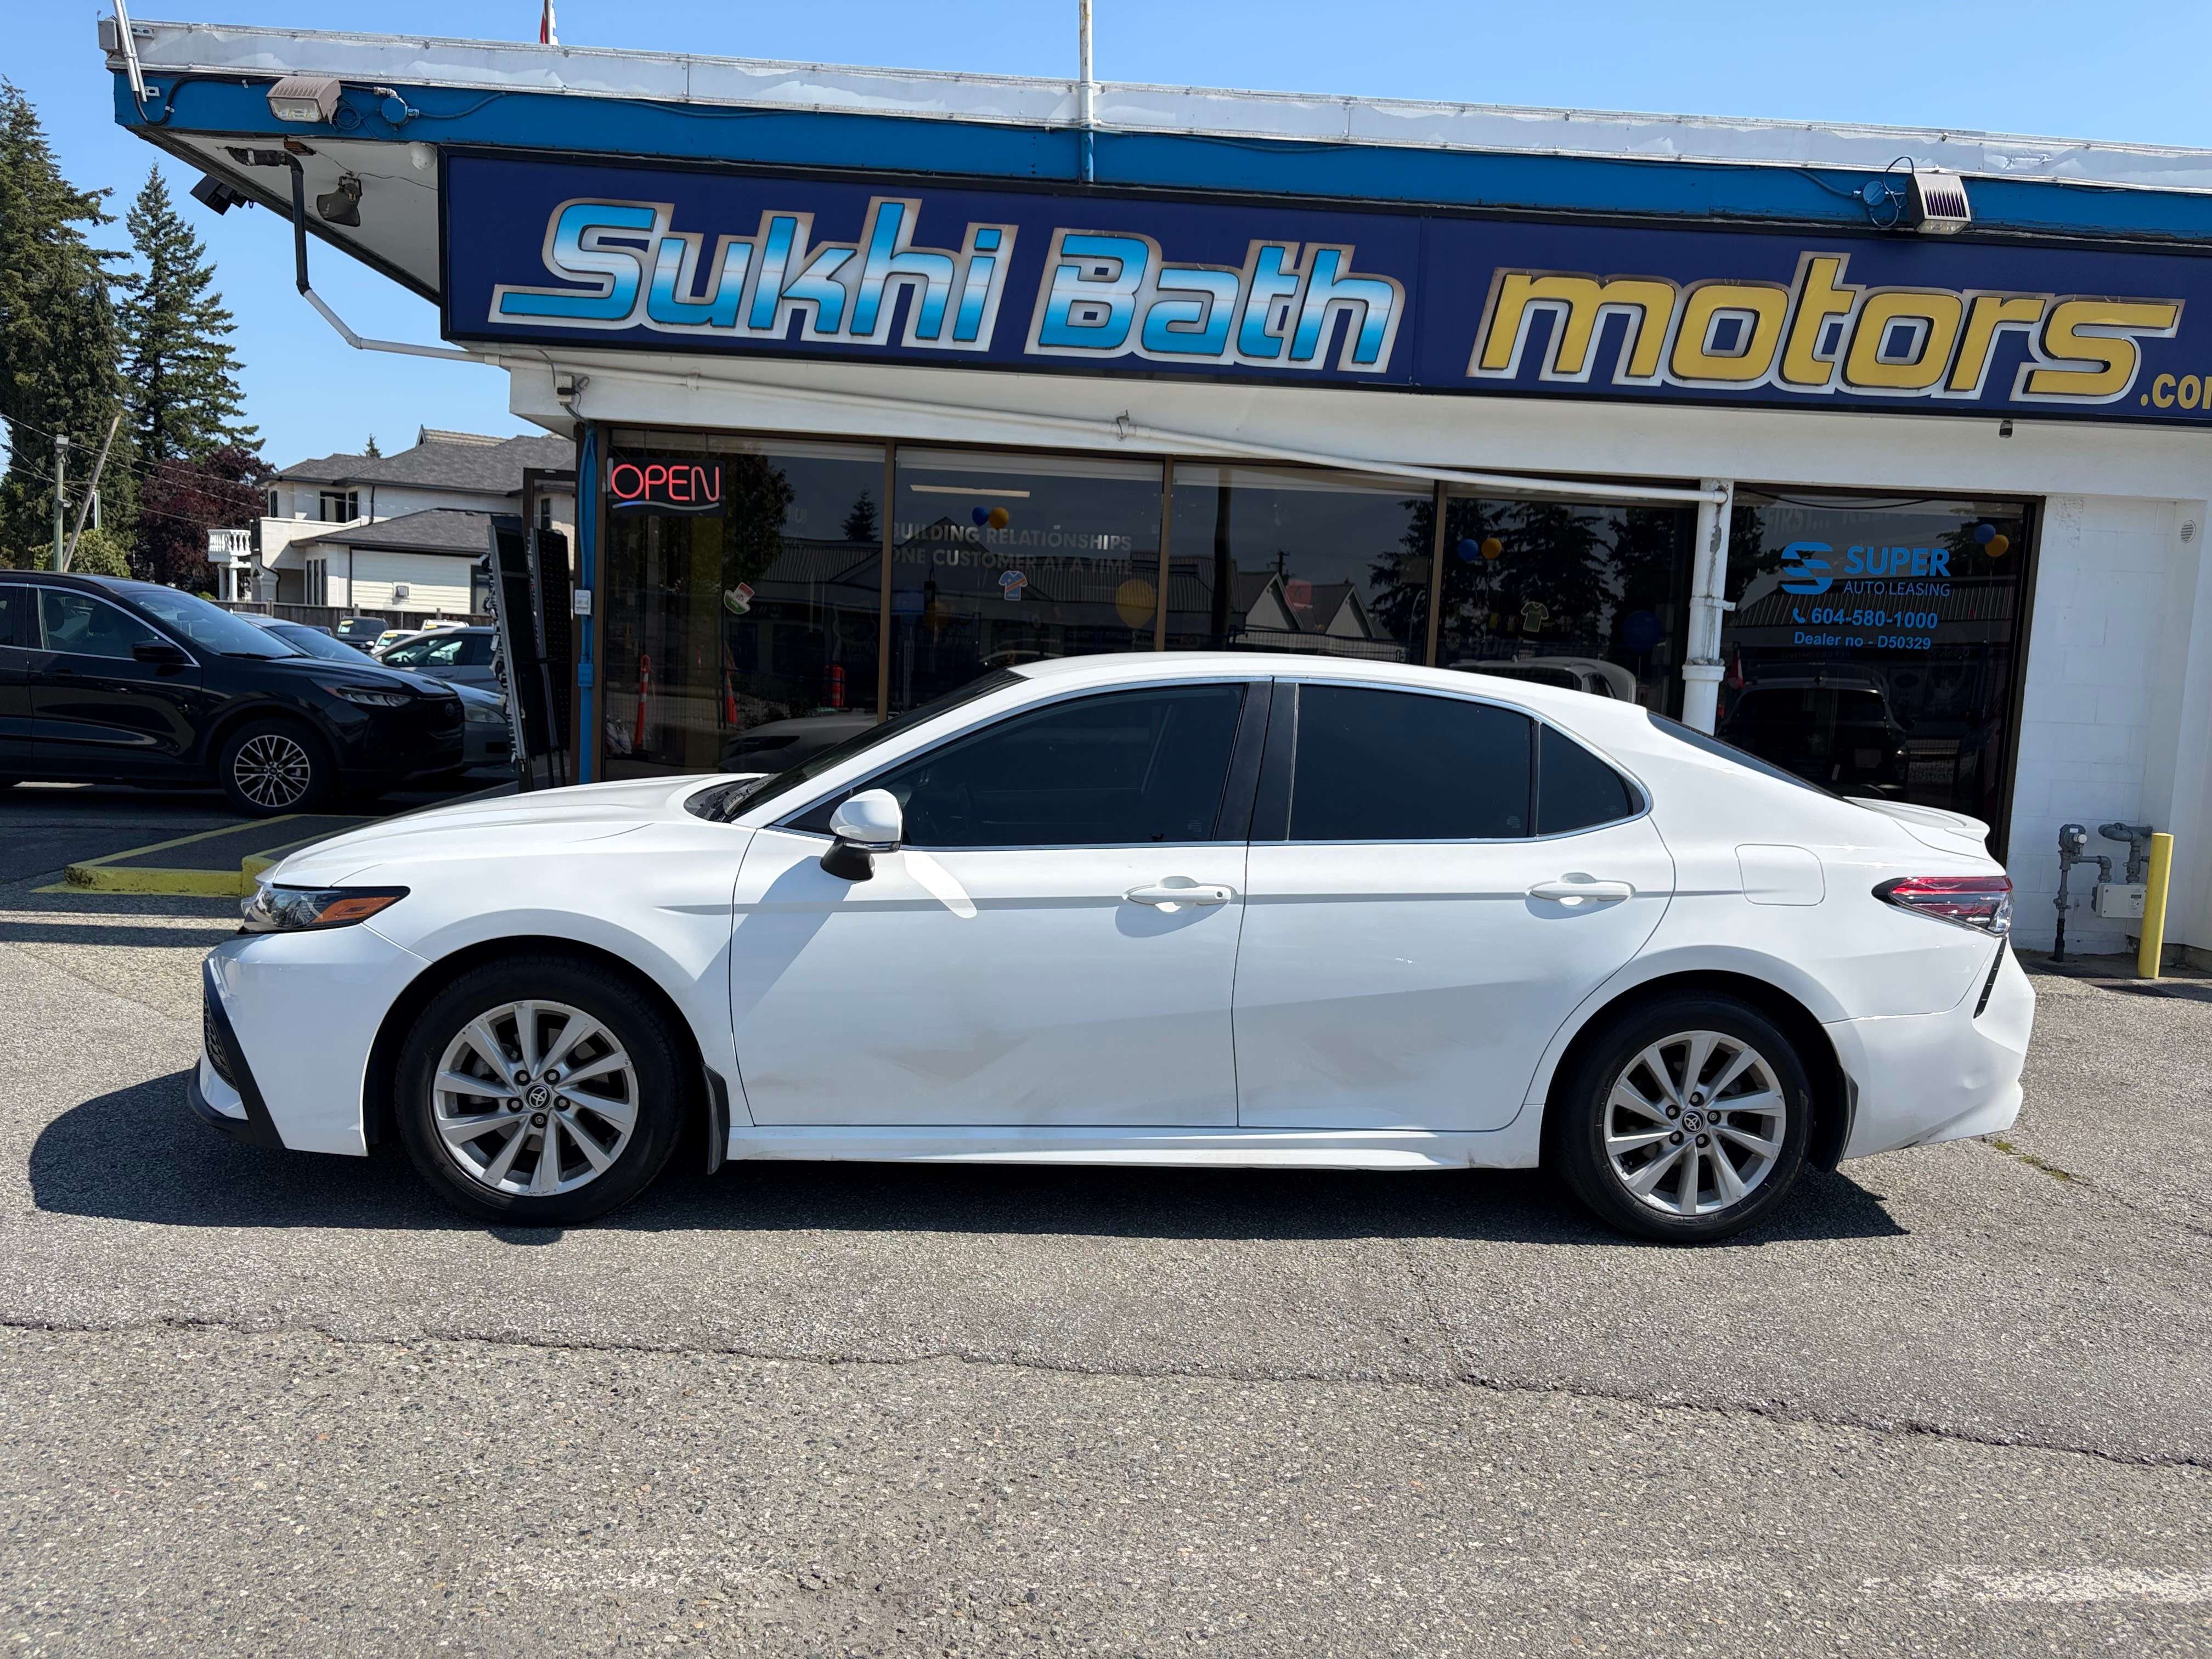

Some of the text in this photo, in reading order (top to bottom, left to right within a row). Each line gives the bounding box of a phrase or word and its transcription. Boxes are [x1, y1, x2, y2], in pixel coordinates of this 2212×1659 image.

[488, 196, 1018, 352] Sukhi
[1024, 228, 1406, 373] Bath
[1465, 251, 2186, 403] motors
[611, 464, 719, 501] OPEN
[987, 528, 1132, 551] RELATIONSHIPS
[933, 549, 1036, 570] CUSTOMER
[1042, 556, 1063, 572] AT
[1092, 557, 1132, 575] TIME
[1844, 546, 1951, 577] SUPER
[1843, 580, 1950, 597] AUTO LEASING
[1812, 608, 1938, 629] 604-580-1000
[1794, 631, 1841, 646] Dealer
[1845, 636, 1864, 647] no
[1877, 635, 1931, 650] D50329
